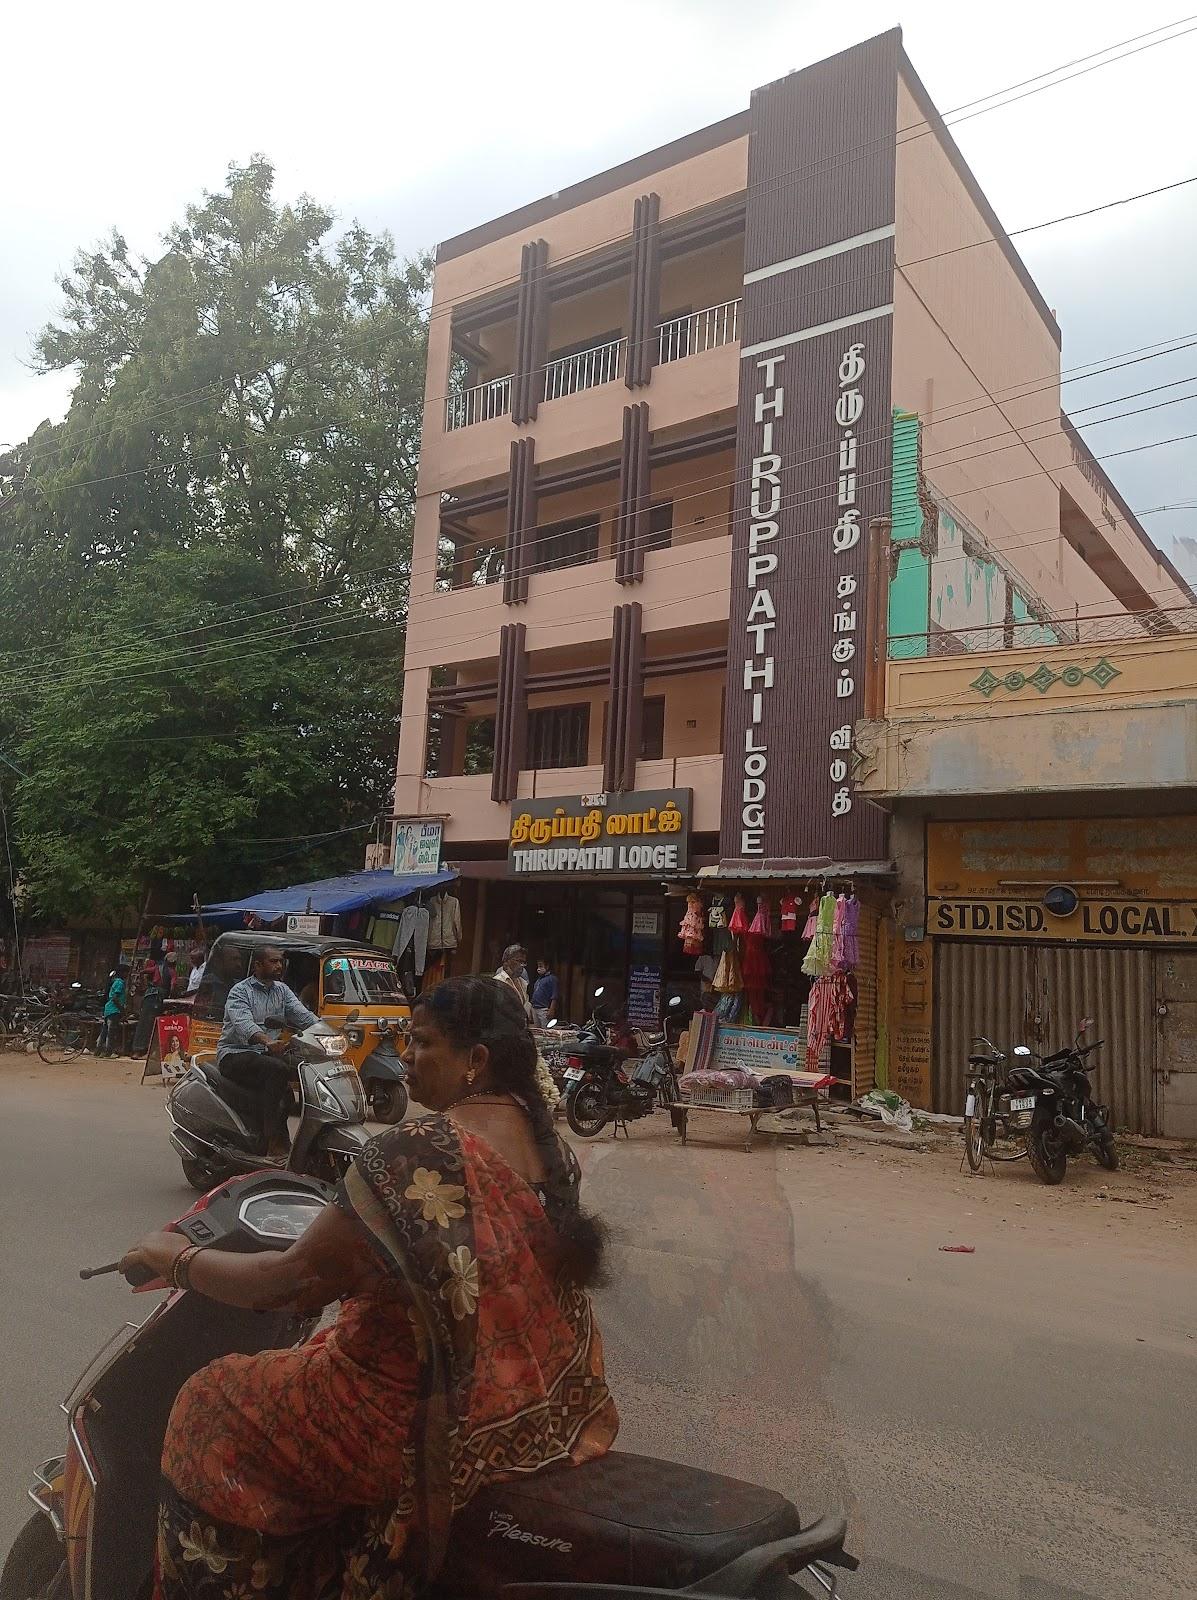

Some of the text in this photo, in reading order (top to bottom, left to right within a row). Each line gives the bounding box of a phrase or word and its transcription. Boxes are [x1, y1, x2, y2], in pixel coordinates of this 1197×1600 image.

[740, 353, 786, 855] THIRUPPATHI LODGE
[828, 342, 866, 819] திருப்பதி தங்கும் விடுதி
[510, 800, 682, 848] திருப்பதி லாட்ஜ்
[512, 844, 678, 872] THIRUPPATHI LODGE
[487, 1520, 573, 1553] Pleasure
